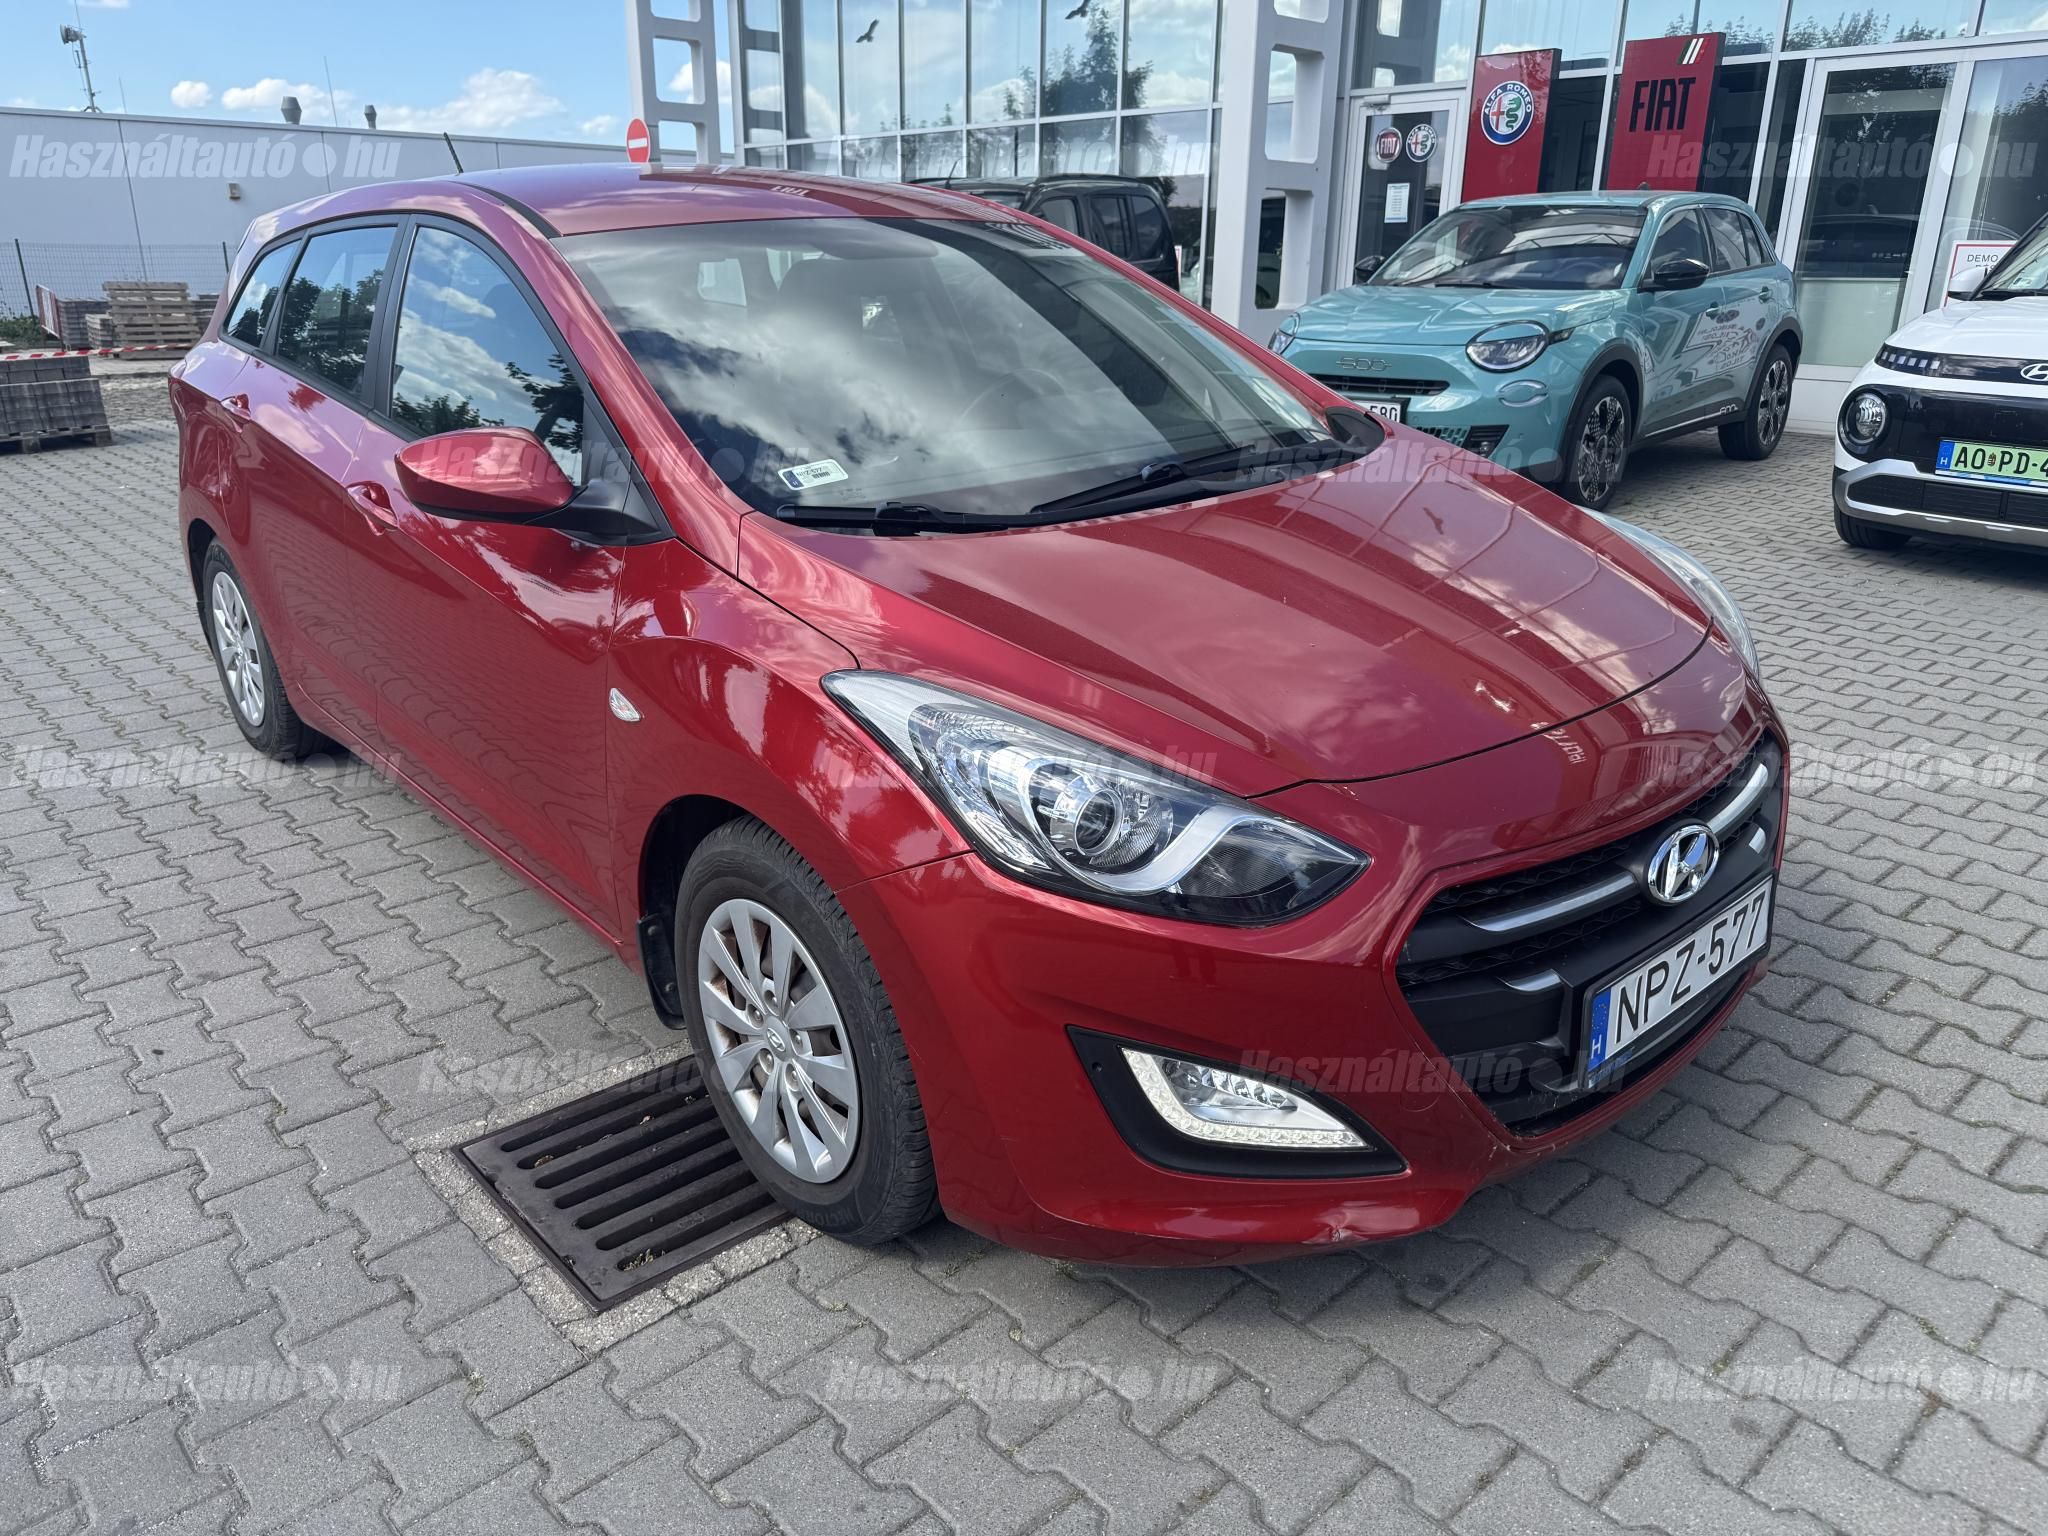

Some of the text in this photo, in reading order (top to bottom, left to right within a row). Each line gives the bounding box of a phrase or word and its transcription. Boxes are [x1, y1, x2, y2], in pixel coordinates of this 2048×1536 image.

[1484, 84, 1532, 115] ALFA ROMEO
[1628, 77, 1697, 132] FIAT
[1380, 137, 1397, 155] FIAT
[1966, 254, 1999, 263] DEMO
[1940, 456, 1948, 466] H
[1954, 446, 1987, 470] AO
[1615, 889, 1766, 1044] NPZ-577
[1590, 1034, 1602, 1060] H
